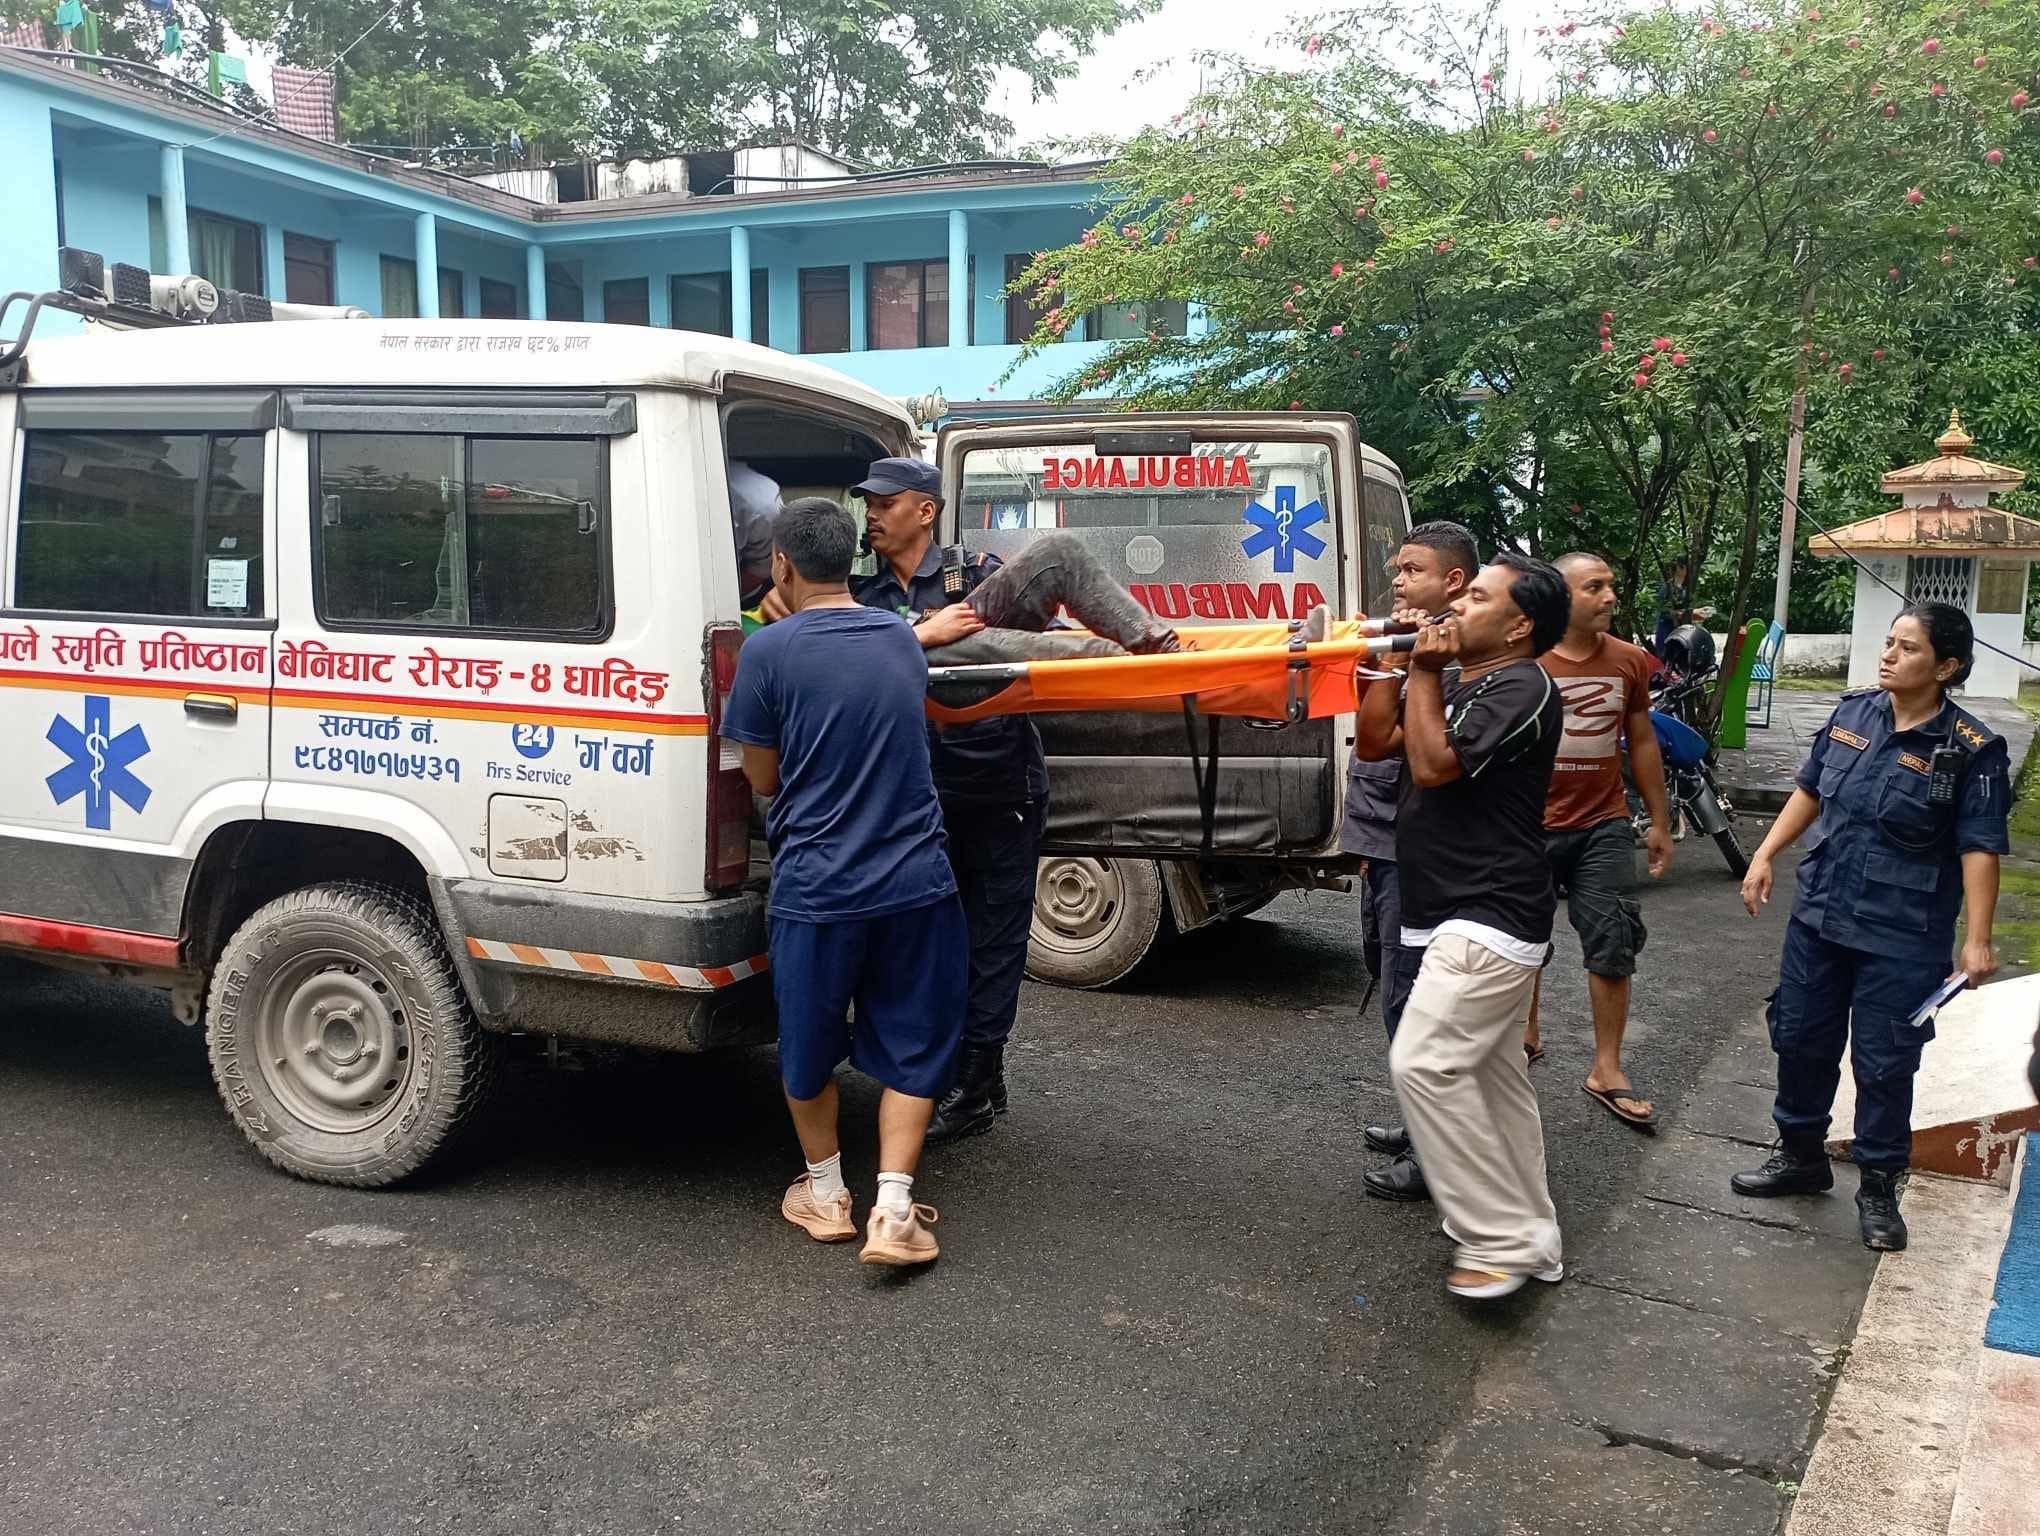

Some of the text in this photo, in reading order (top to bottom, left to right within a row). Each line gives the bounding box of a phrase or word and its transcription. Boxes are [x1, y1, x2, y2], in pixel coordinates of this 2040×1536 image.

[414, 336, 453, 351] सरकार
[52, 628, 126, 672] स्मृति
[139, 631, 267, 674] प्रतिष्ठान
[278, 640, 396, 683] बेनिघाट
[318, 715, 402, 741] सम्पर्क
[516, 723, 550, 749] 24
[295, 745, 461, 783] ९८४१७१७५३१
[613, 738, 654, 776] वर्ग
[516, 763, 572, 786] Service
